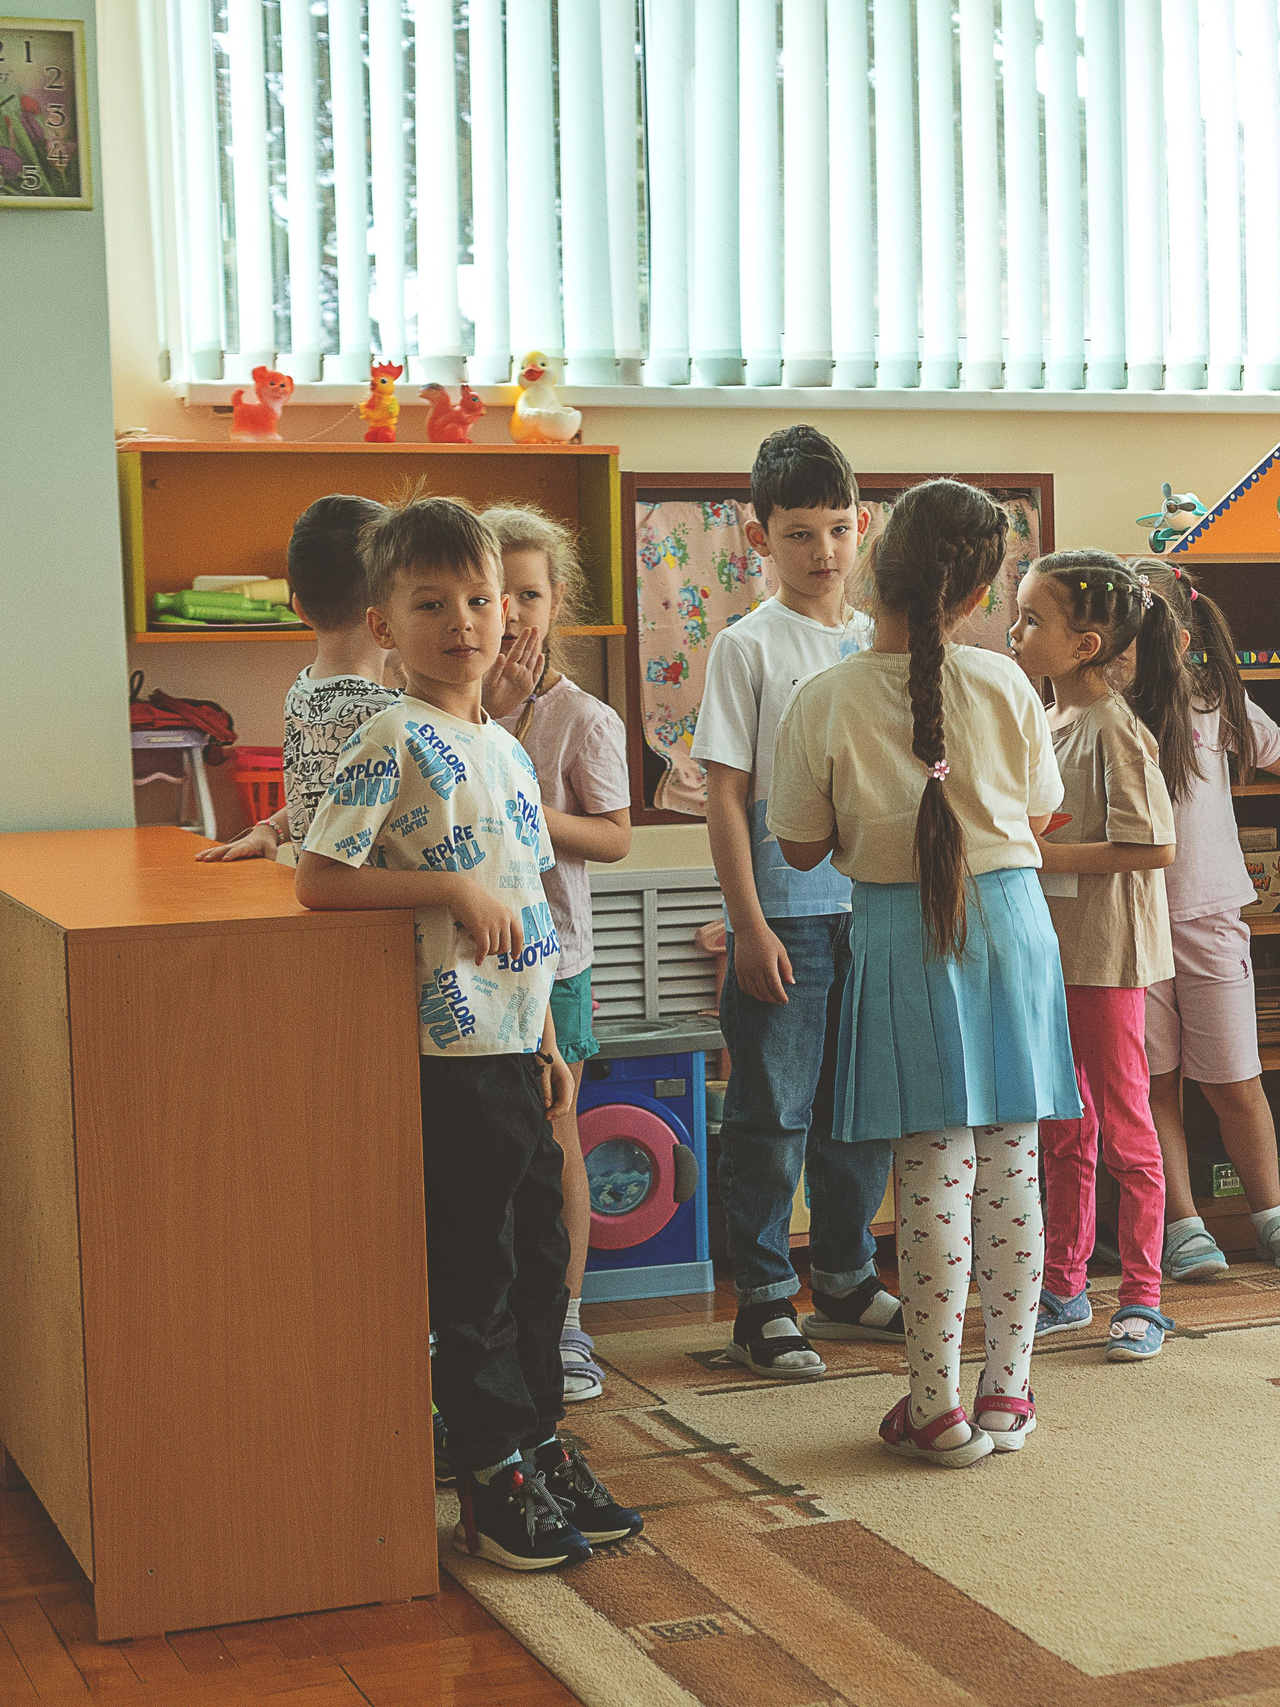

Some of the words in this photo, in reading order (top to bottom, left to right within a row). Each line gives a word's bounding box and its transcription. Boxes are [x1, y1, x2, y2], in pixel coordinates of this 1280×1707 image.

[44, 66, 62, 91] 2
[47, 140, 69, 168] 4
[21, 165, 42, 191] 5
[404, 729, 456, 801] TRAVEL
[418, 723, 467, 785] EXPLORE
[389, 813, 410, 833] RIDE
[410, 804, 430, 820] THE
[356, 827, 373, 843] THE
[400, 815, 429, 838] ENJOY
[334, 835, 357, 853] RIDE
[438, 969, 476, 1038] EXPLORE
